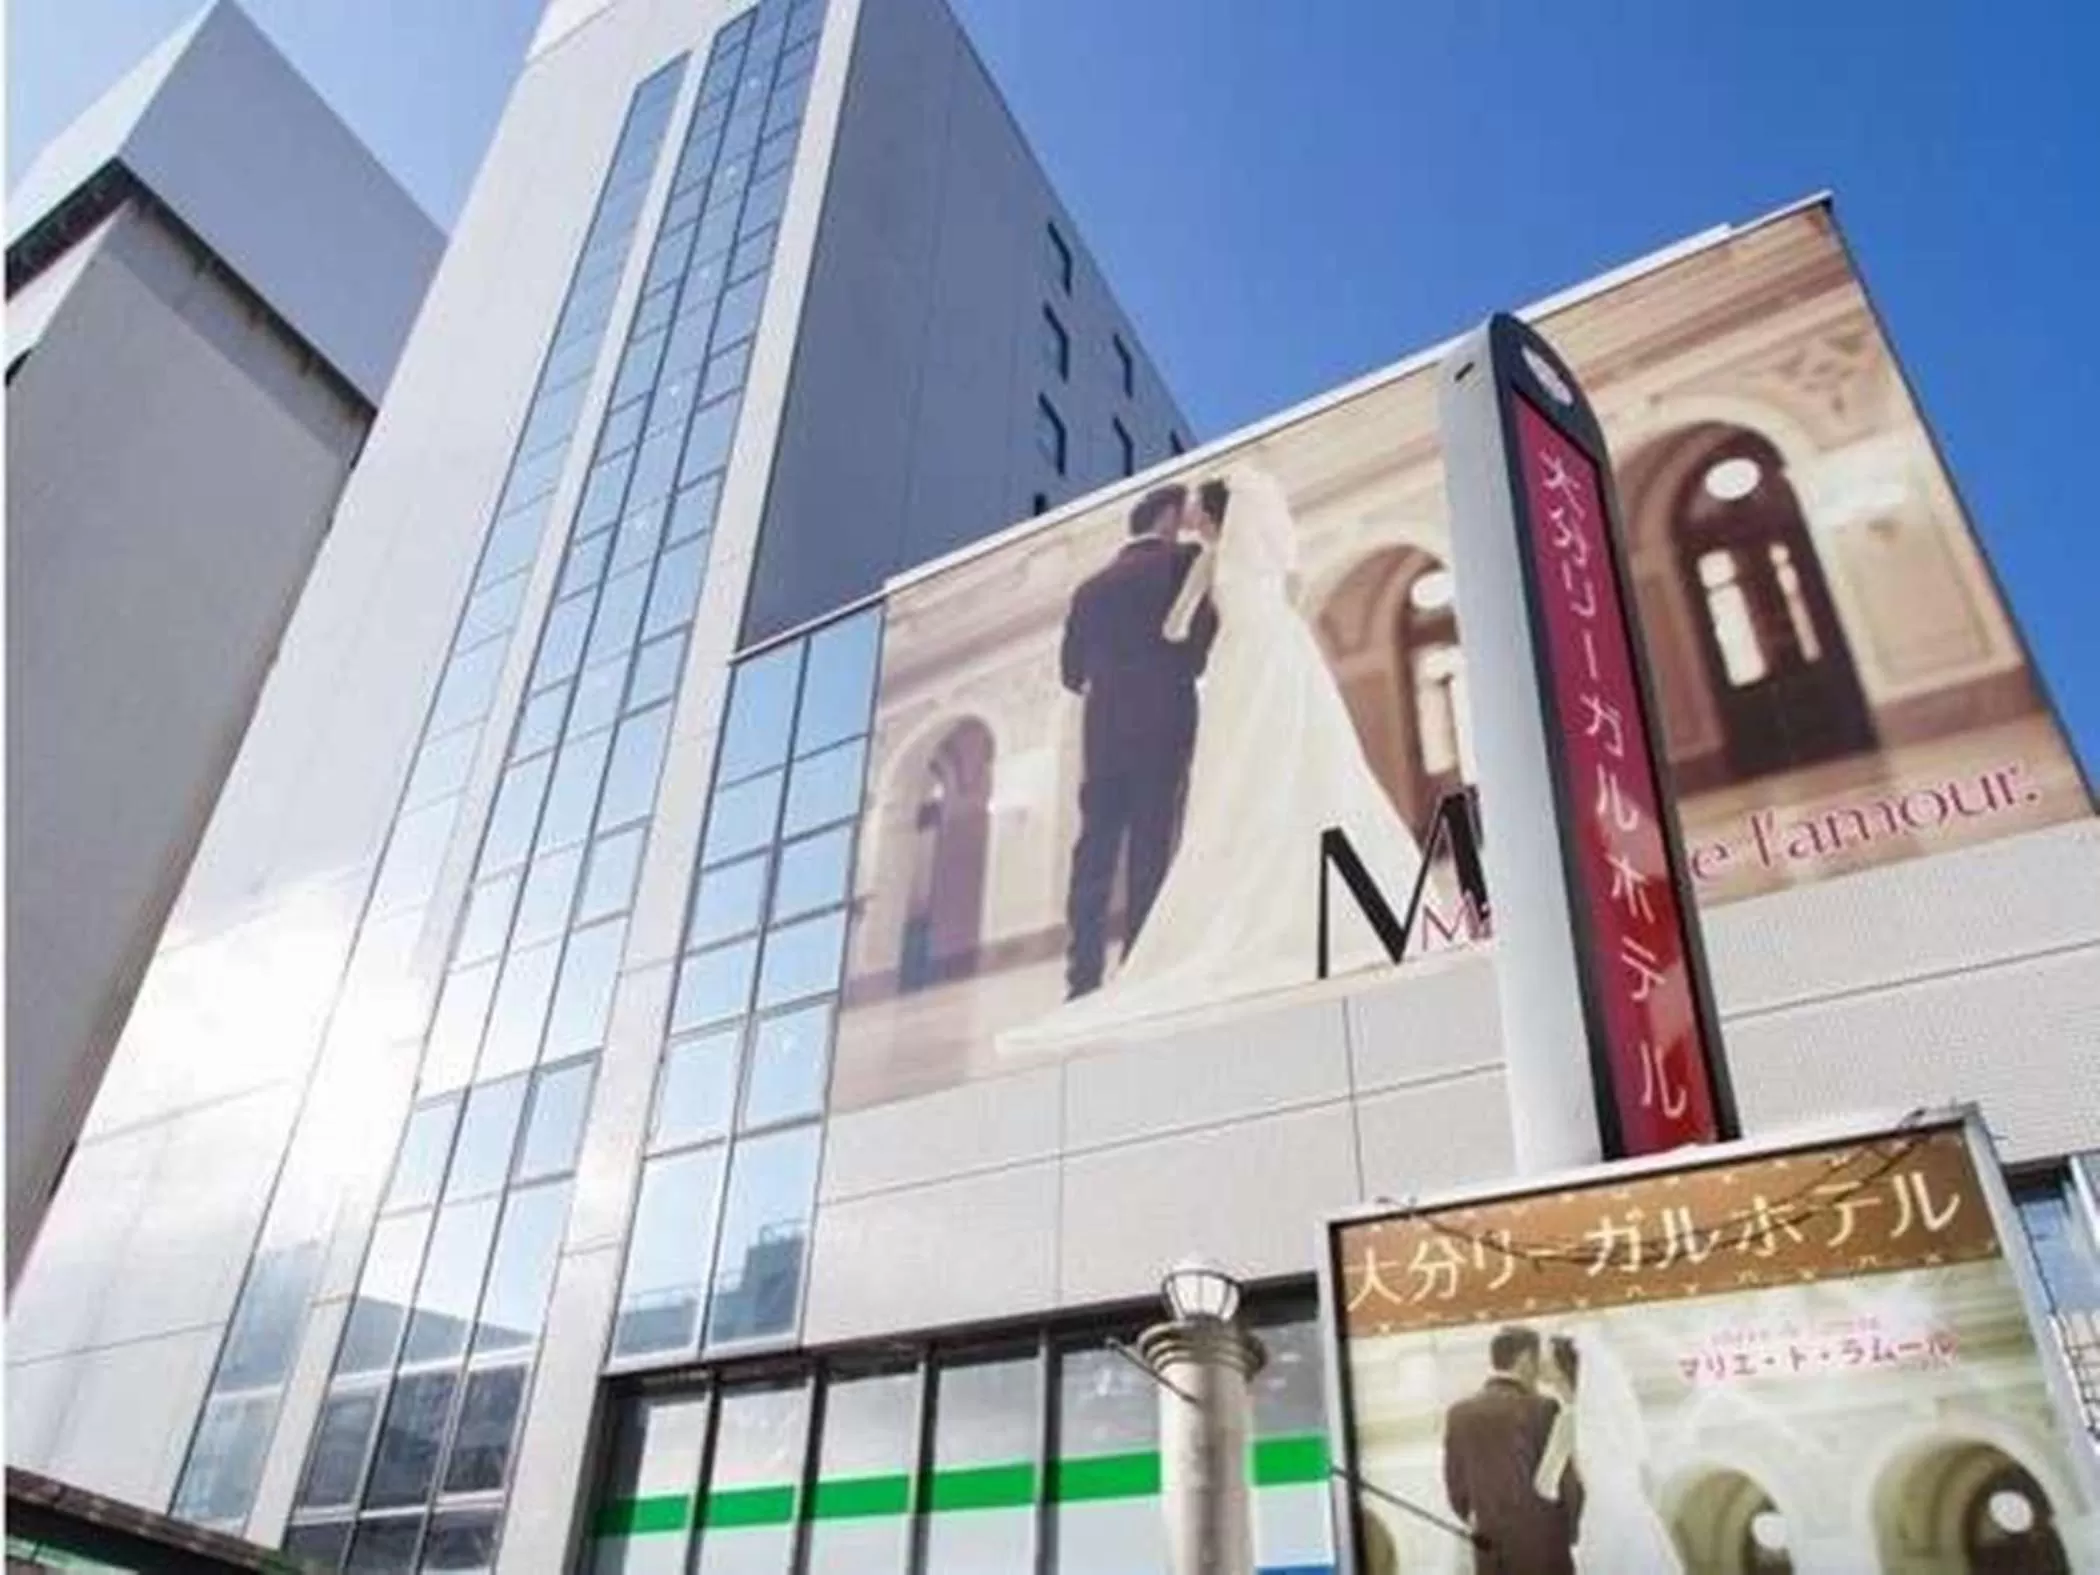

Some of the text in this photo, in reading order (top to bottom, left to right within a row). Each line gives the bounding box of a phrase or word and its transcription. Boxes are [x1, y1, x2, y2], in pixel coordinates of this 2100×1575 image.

[1346, 1171, 1960, 1312] 大分リーガルホテル
